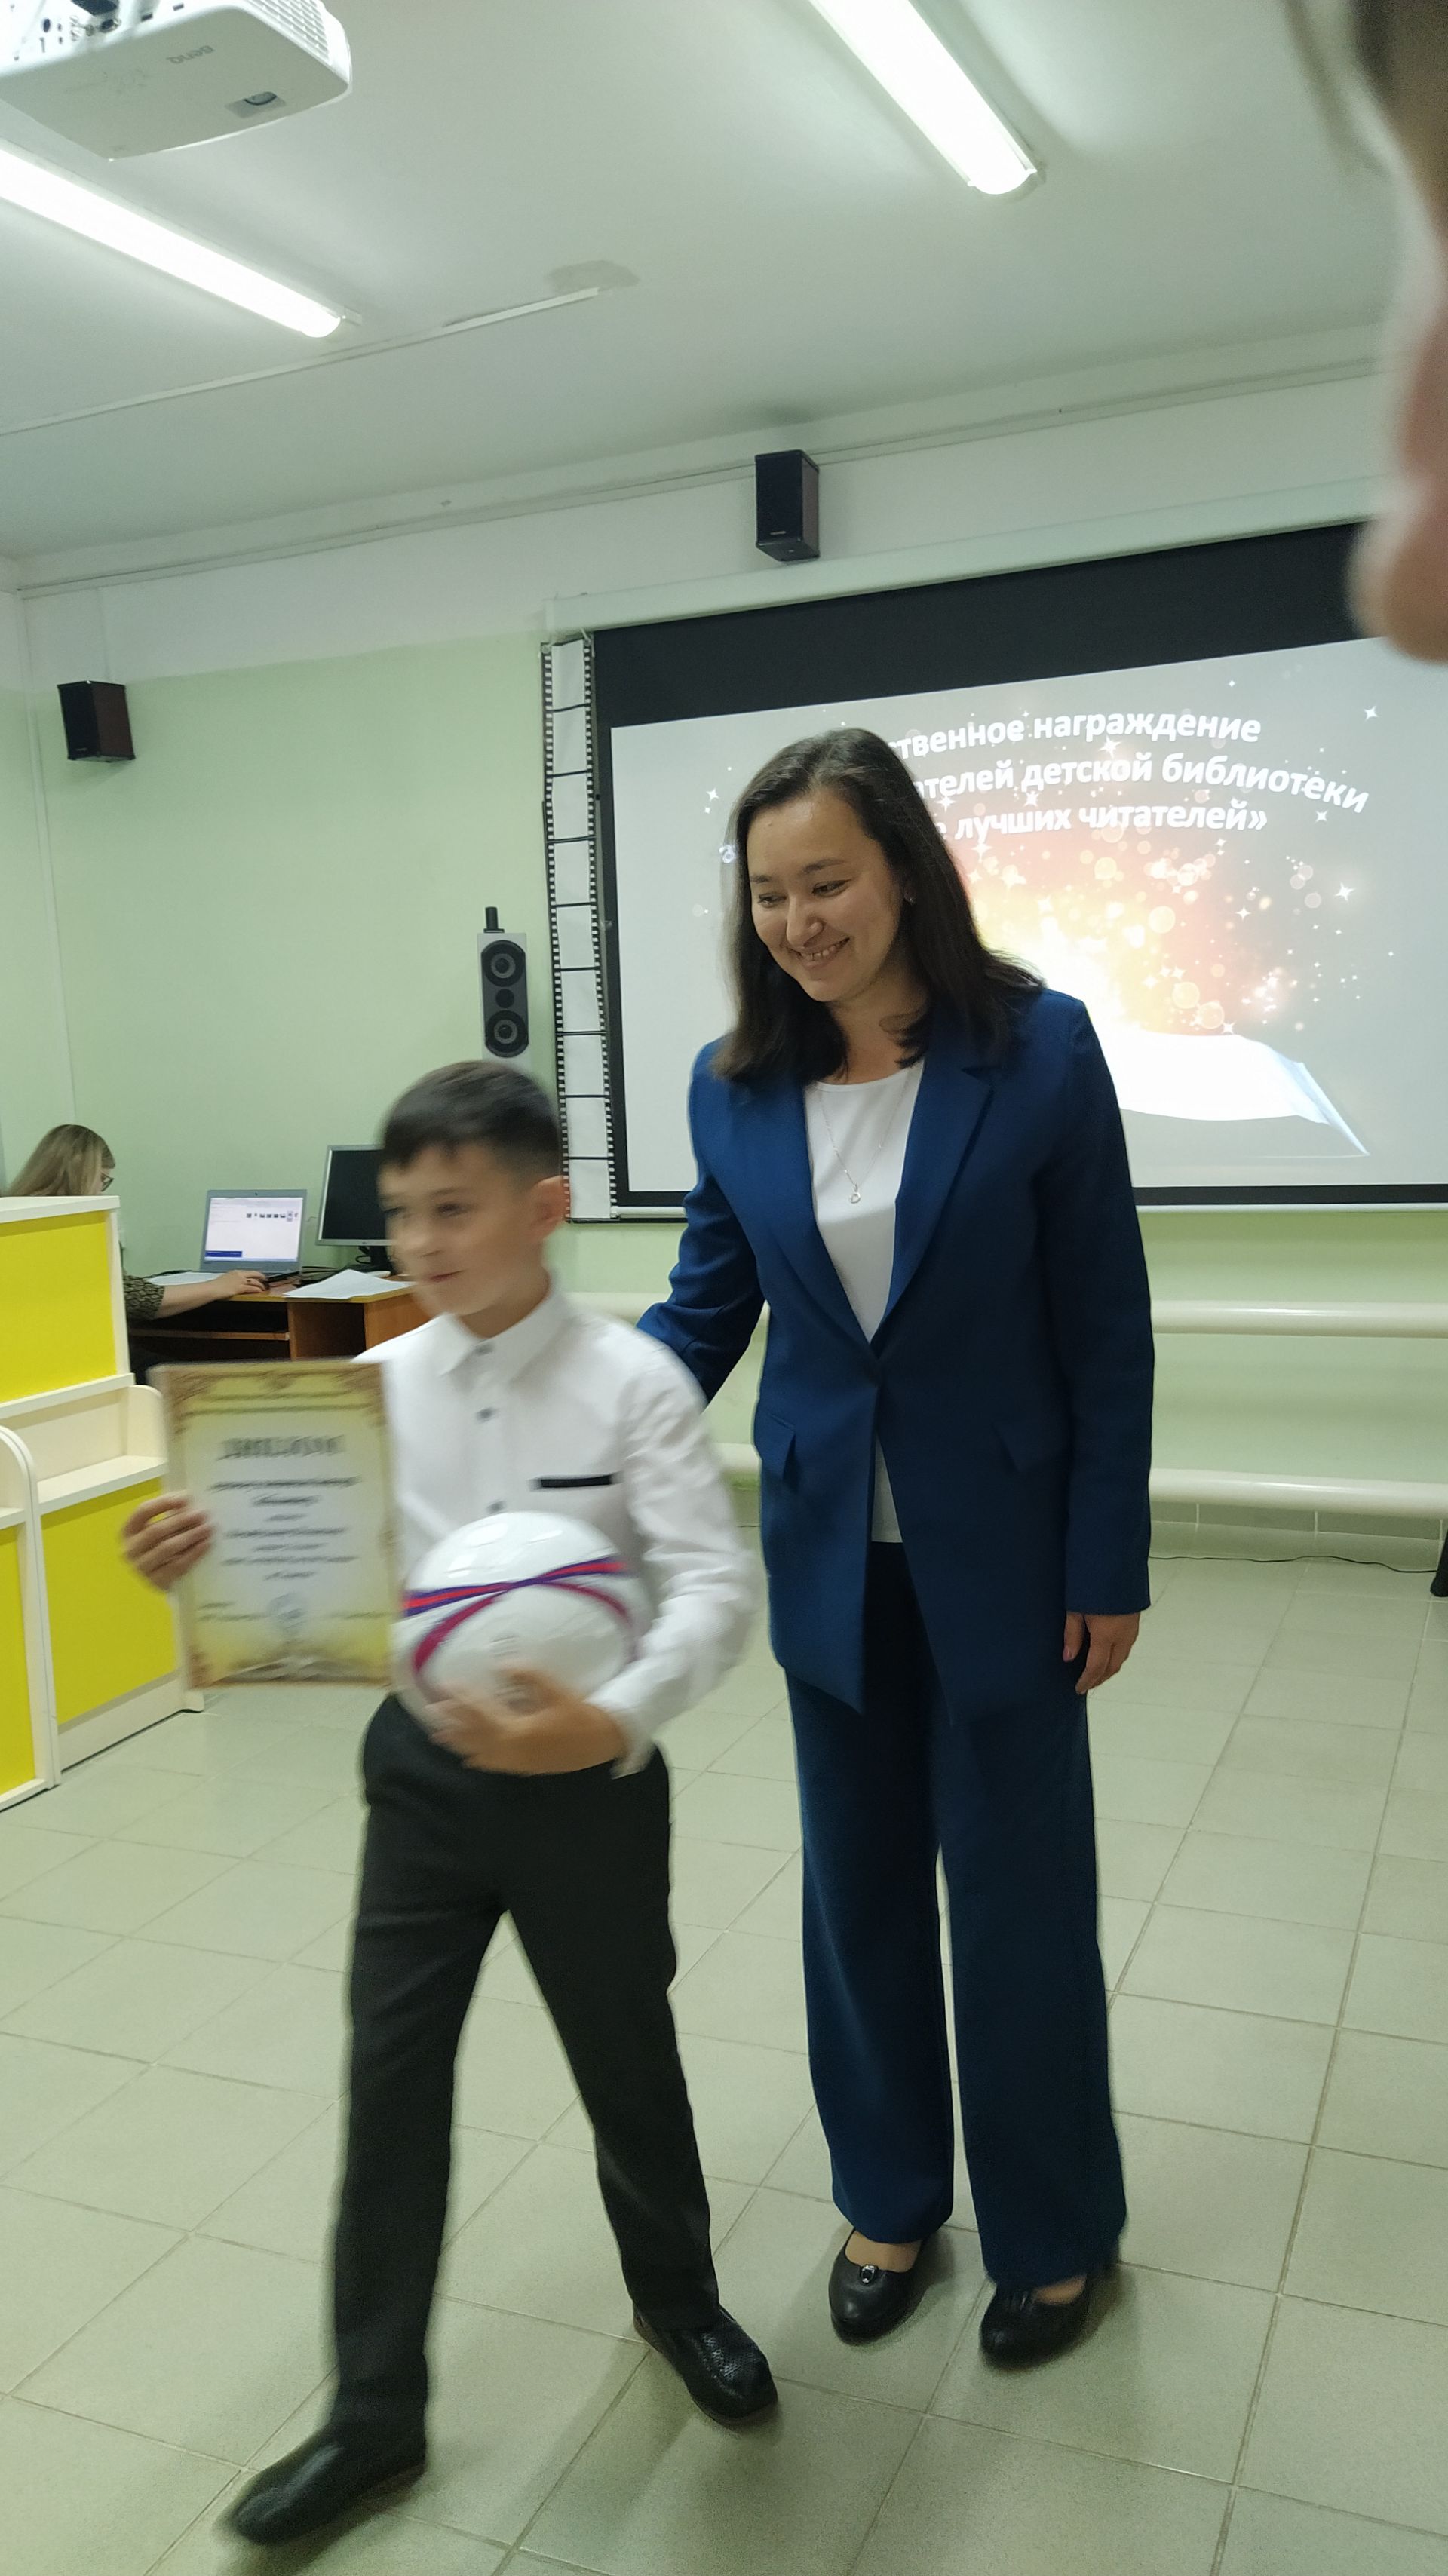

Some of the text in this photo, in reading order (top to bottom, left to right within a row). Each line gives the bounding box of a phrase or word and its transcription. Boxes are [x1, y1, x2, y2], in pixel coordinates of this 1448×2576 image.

[1033, 713, 1261, 743] награждение
[1020, 752, 1152, 793] детской
[1161, 753, 1370, 814] библиотеки
[954, 808, 1072, 845] лучших
[1078, 799, 1268, 830] читателей»
